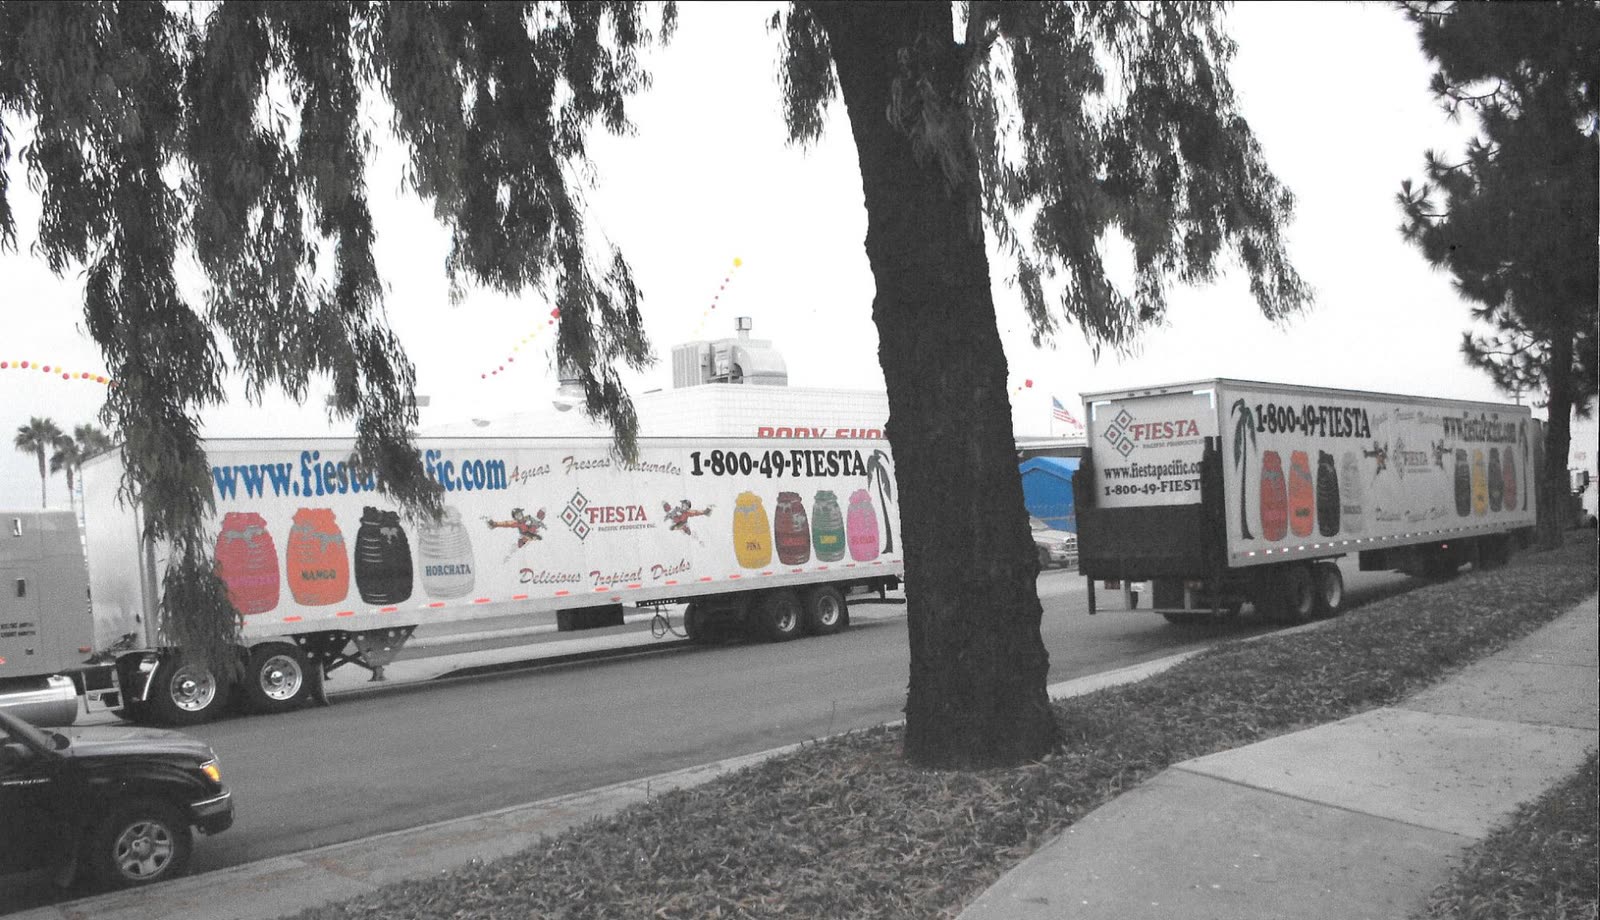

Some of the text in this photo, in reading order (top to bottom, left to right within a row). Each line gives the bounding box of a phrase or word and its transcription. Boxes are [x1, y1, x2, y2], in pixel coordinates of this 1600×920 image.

[1129, 419, 1199, 441] FIESTA
[1255, 403, 1371, 439] 1-800-49-FIESTA
[835, 428, 887, 440] SHO
[508, 464, 551, 487] Aguas
[562, 455, 611, 475] Frescas
[690, 449, 868, 479] 1-800-49-FIESTA
[1103, 460, 1201, 480] www.fiestapacific.co
[1104, 479, 1201, 496] 1-800-49-FIEST
[584, 505, 647, 523] FIESTA
[301, 569, 337, 581] MANGO
[425, 564, 471, 577] HORCHATA
[519, 558, 691, 586] Delicious Tropical Drinks
